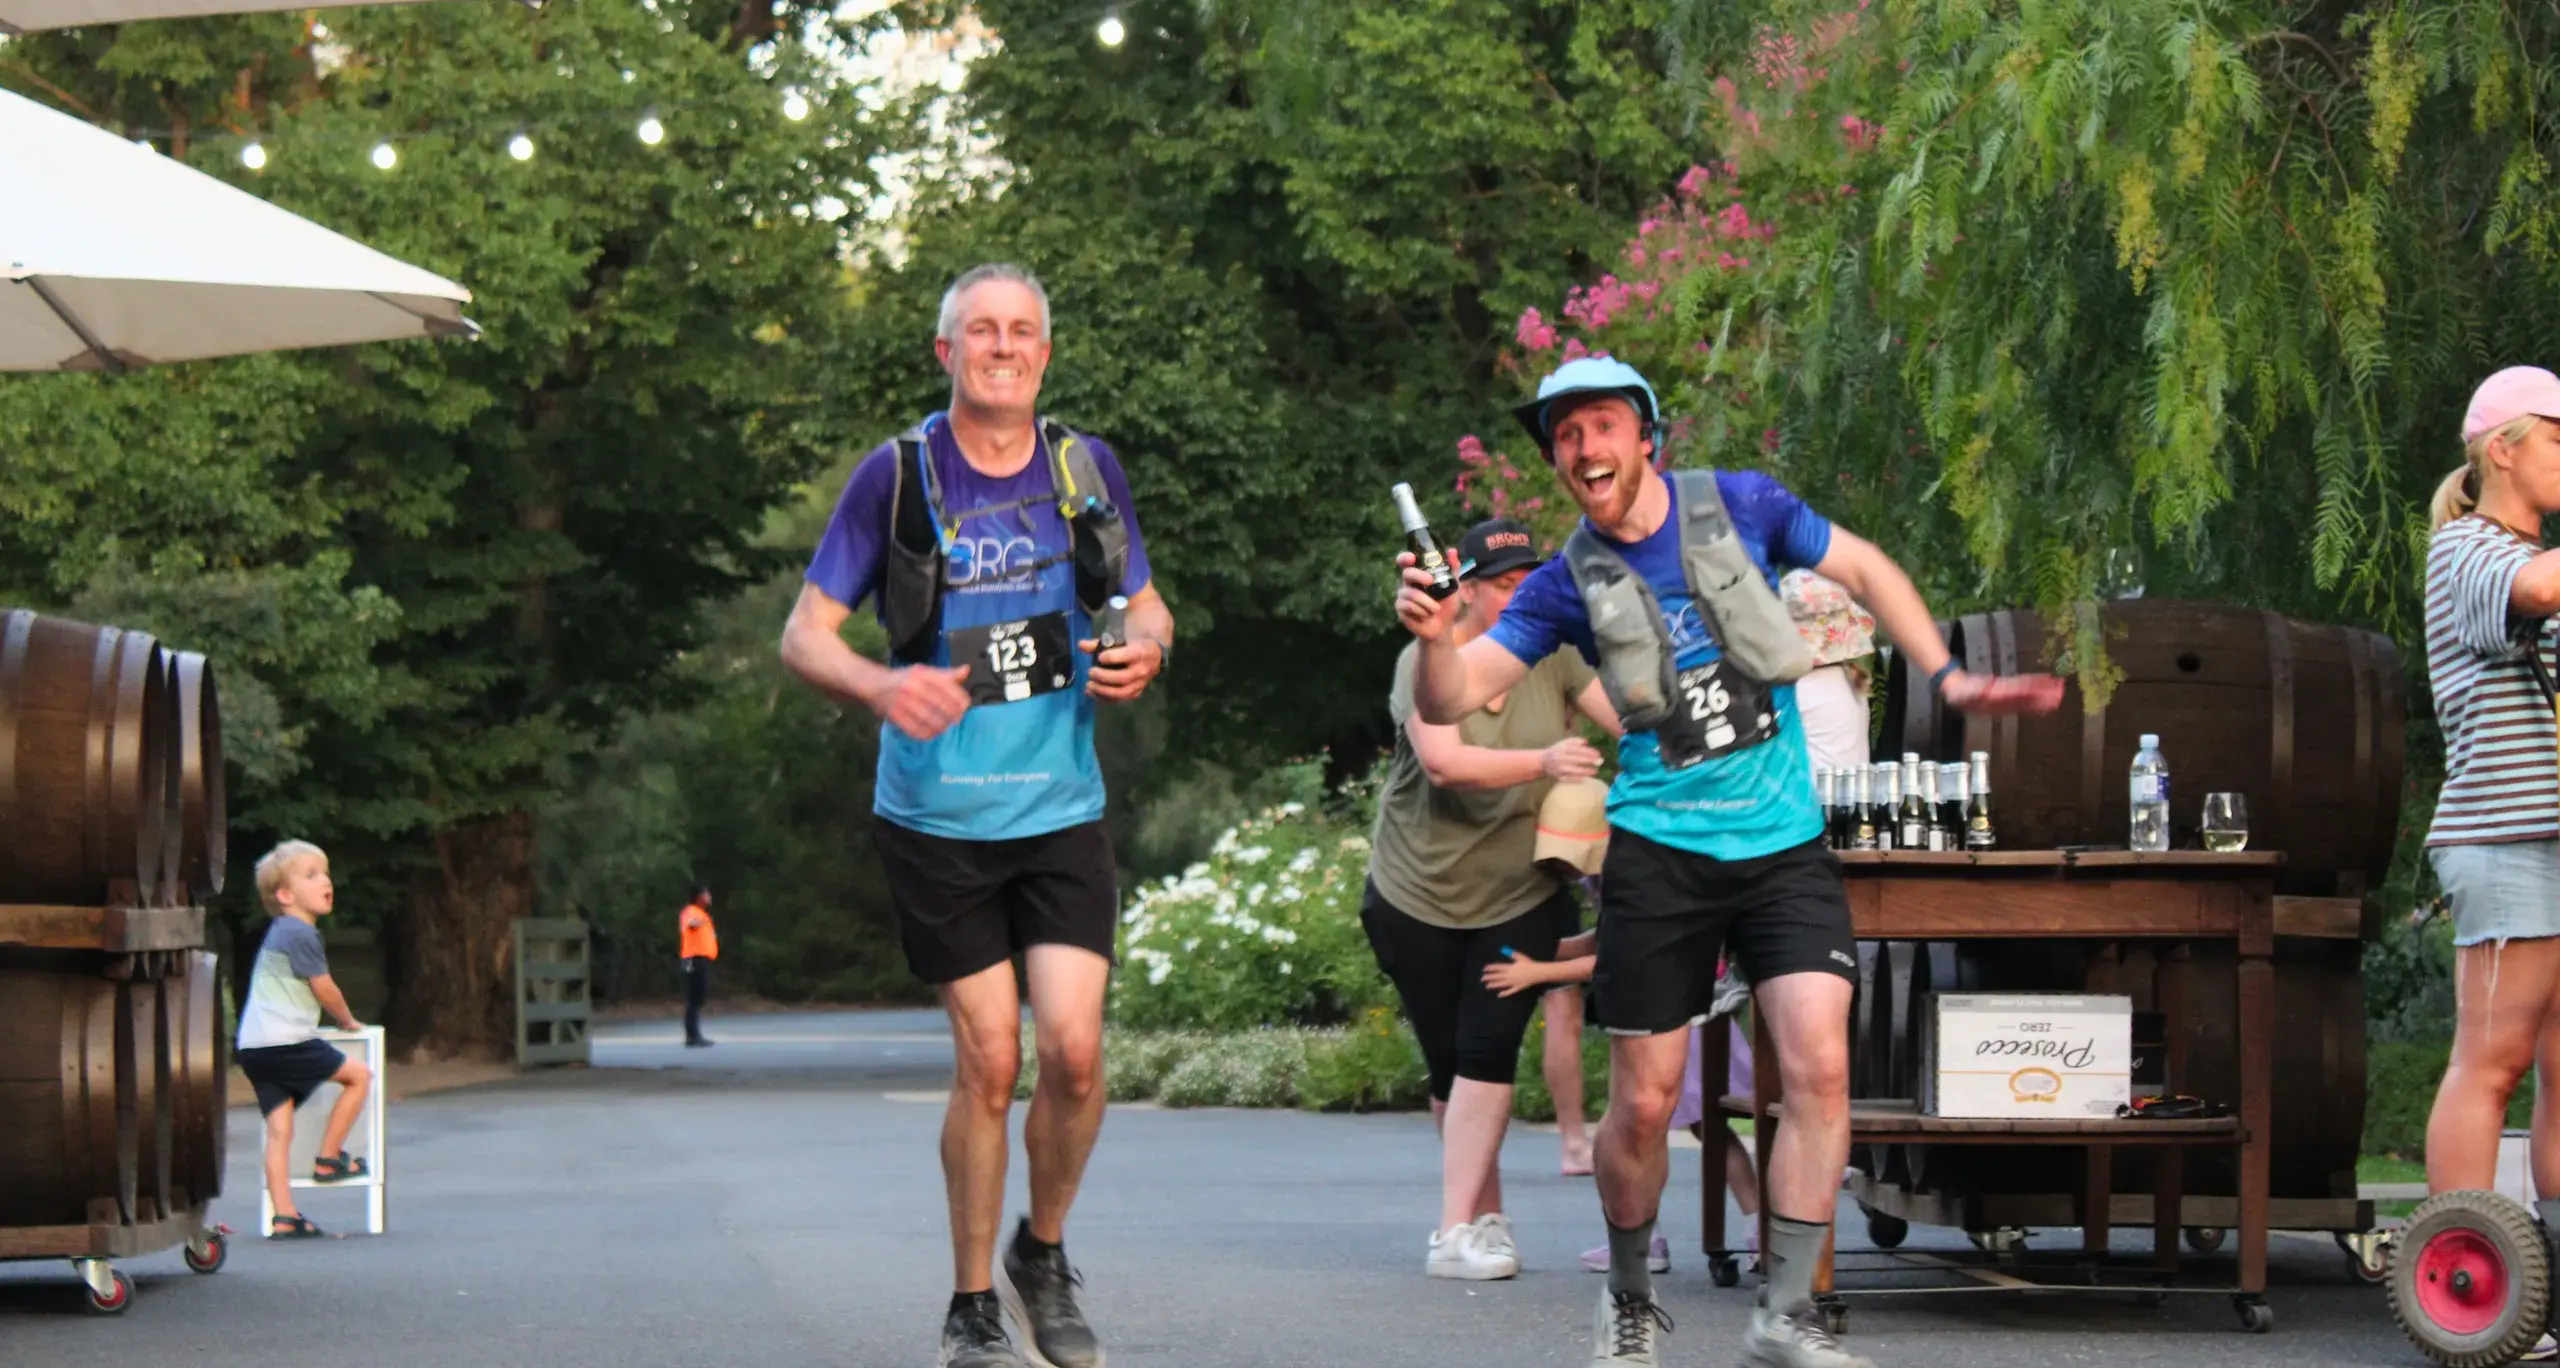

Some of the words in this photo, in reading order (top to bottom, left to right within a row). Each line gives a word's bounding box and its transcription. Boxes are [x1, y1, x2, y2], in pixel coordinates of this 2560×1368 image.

[945, 536, 1035, 586] BRG
[987, 636, 1037, 672] 123
[1685, 679, 1731, 721] 26
[2019, 1022, 2052, 1033] ZERO
[1975, 1037, 2096, 1068] Prosecco
